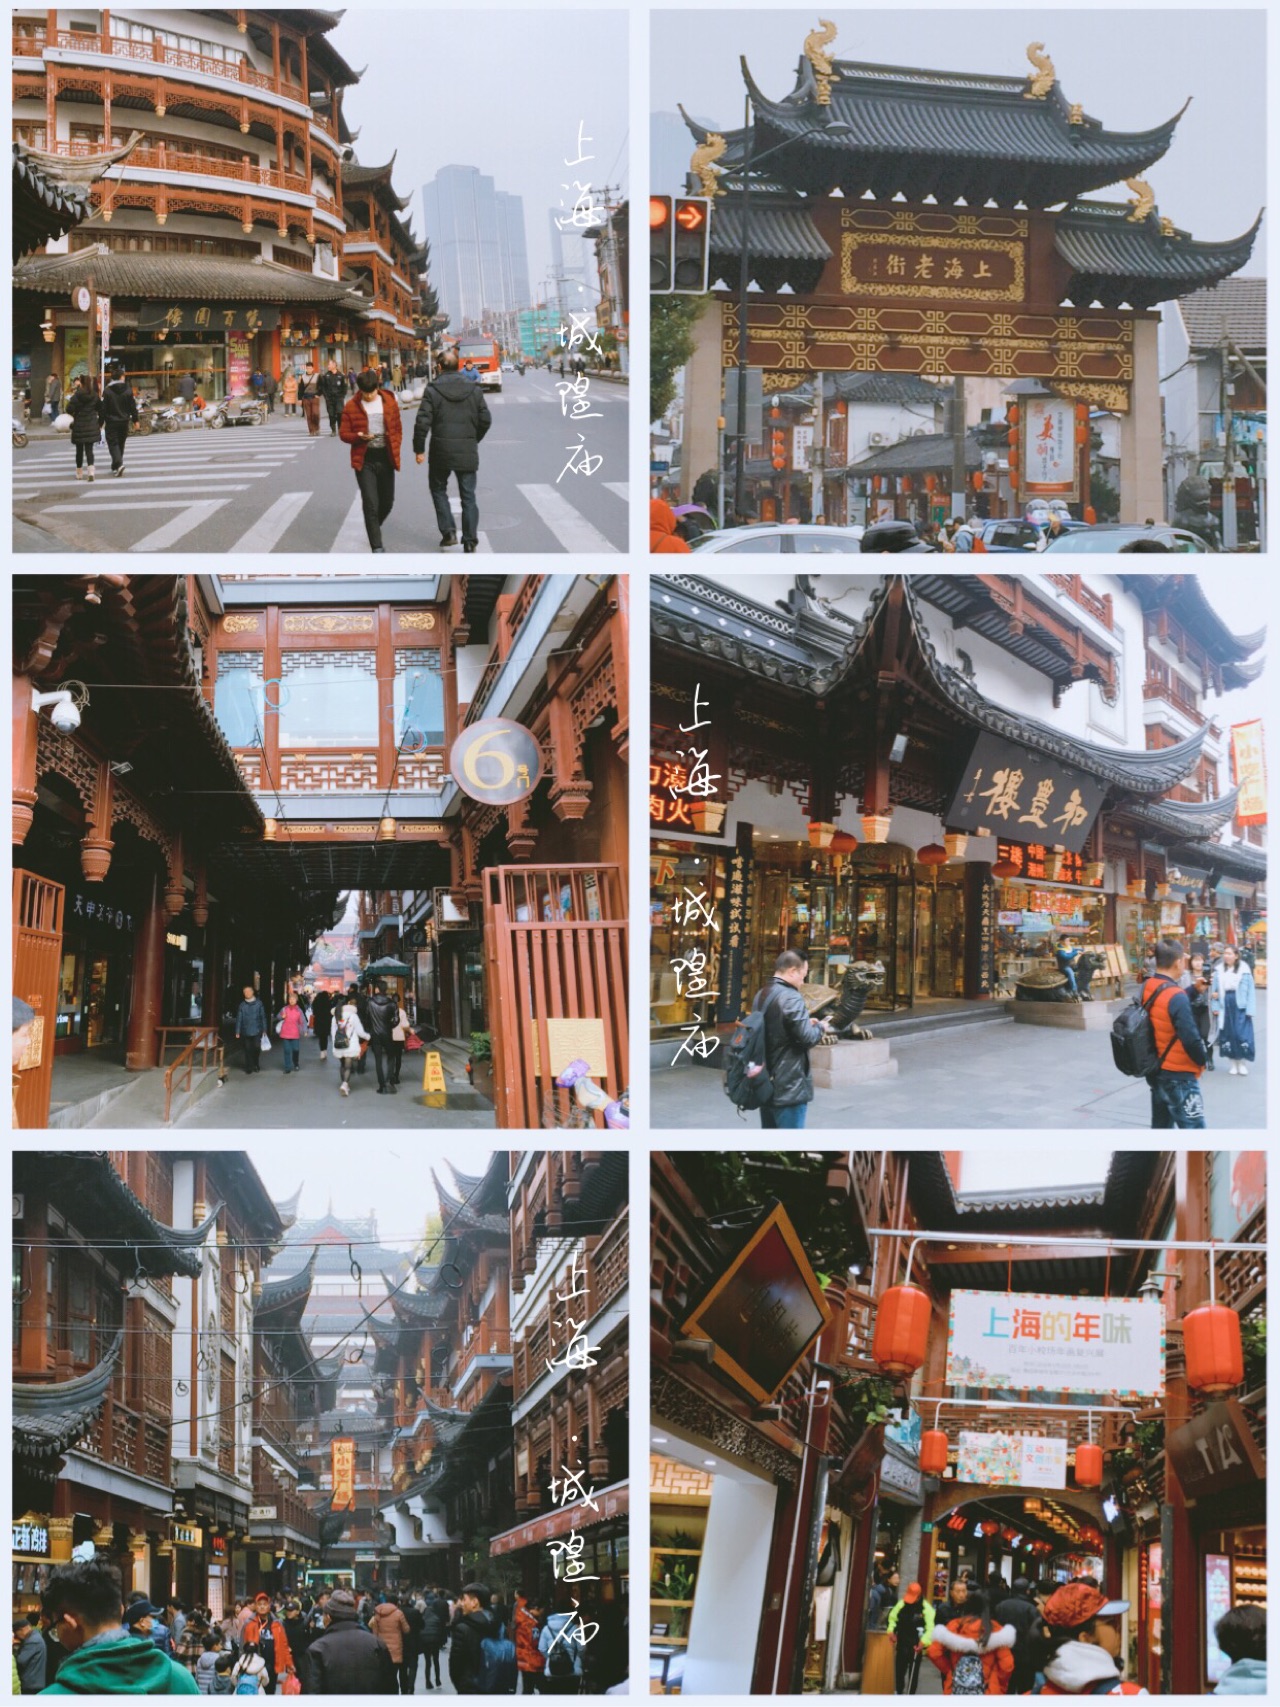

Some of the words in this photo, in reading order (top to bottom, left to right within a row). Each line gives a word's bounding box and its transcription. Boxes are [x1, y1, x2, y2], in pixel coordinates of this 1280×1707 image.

[886, 252, 992, 280] 上海老街
[982, 1306, 1132, 1344] 上海的年味
